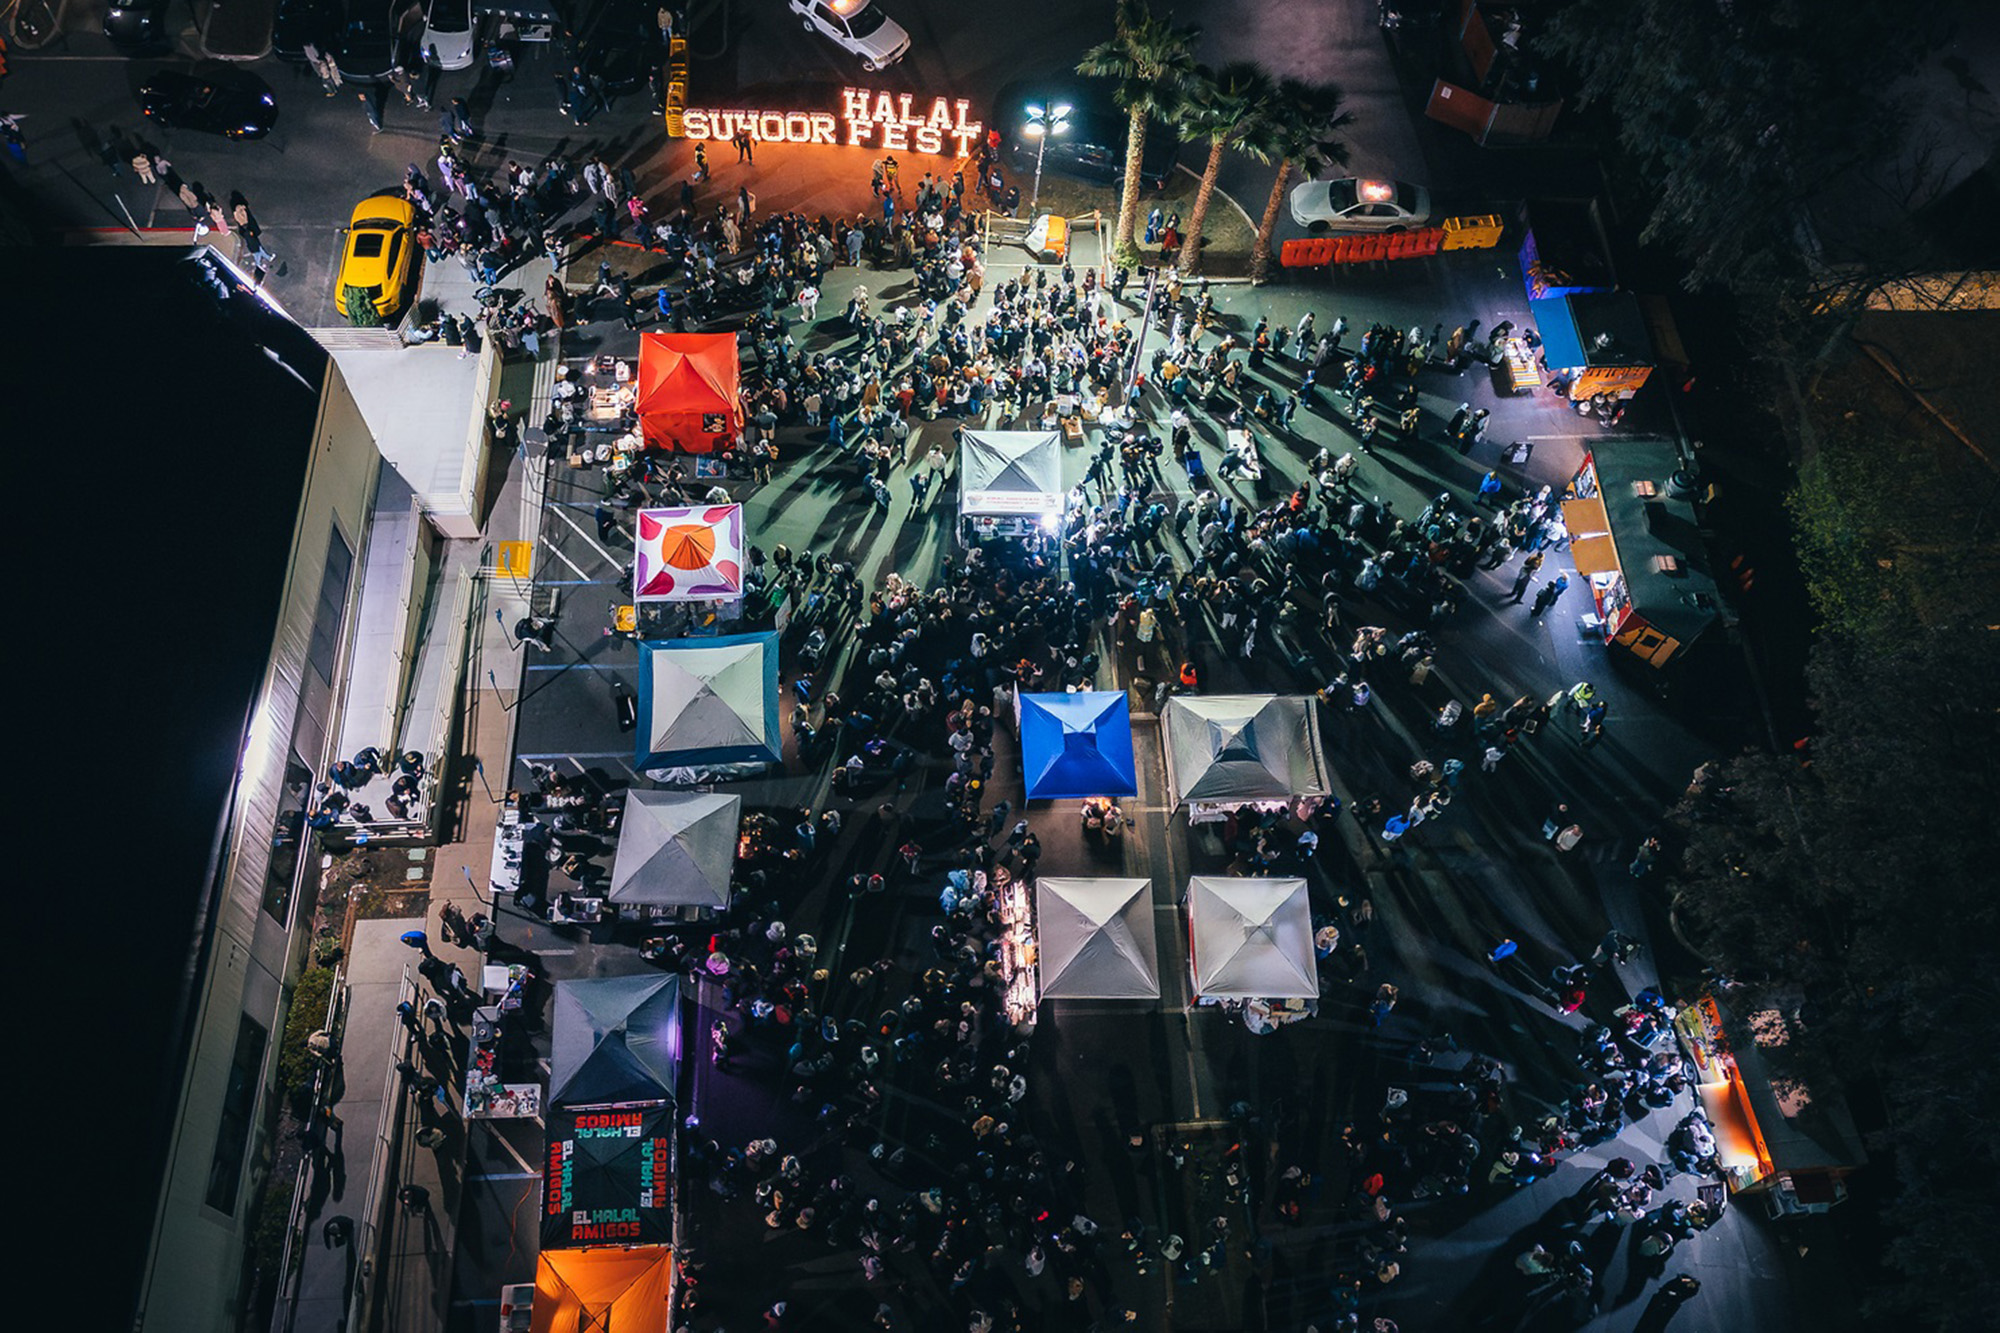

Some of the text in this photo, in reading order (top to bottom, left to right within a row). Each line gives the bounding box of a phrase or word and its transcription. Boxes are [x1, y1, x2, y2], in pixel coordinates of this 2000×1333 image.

[682, 108, 836, 144] SUHOOR
[843, 86, 982, 133] HALAL
[847, 119, 981, 158] FEST
[574, 1126, 642, 1139] EL HALAL
[575, 1113, 642, 1128] AMIGOS
[547, 1141, 562, 1215] AMIGOS
[560, 1139, 574, 1213] EL HALAL
[641, 1137, 654, 1208] EL HALAL
[653, 1137, 668, 1208] AMIGOS
[571, 1222, 641, 1240] AMIGOS
[572, 1208, 640, 1224] EL HALAL
